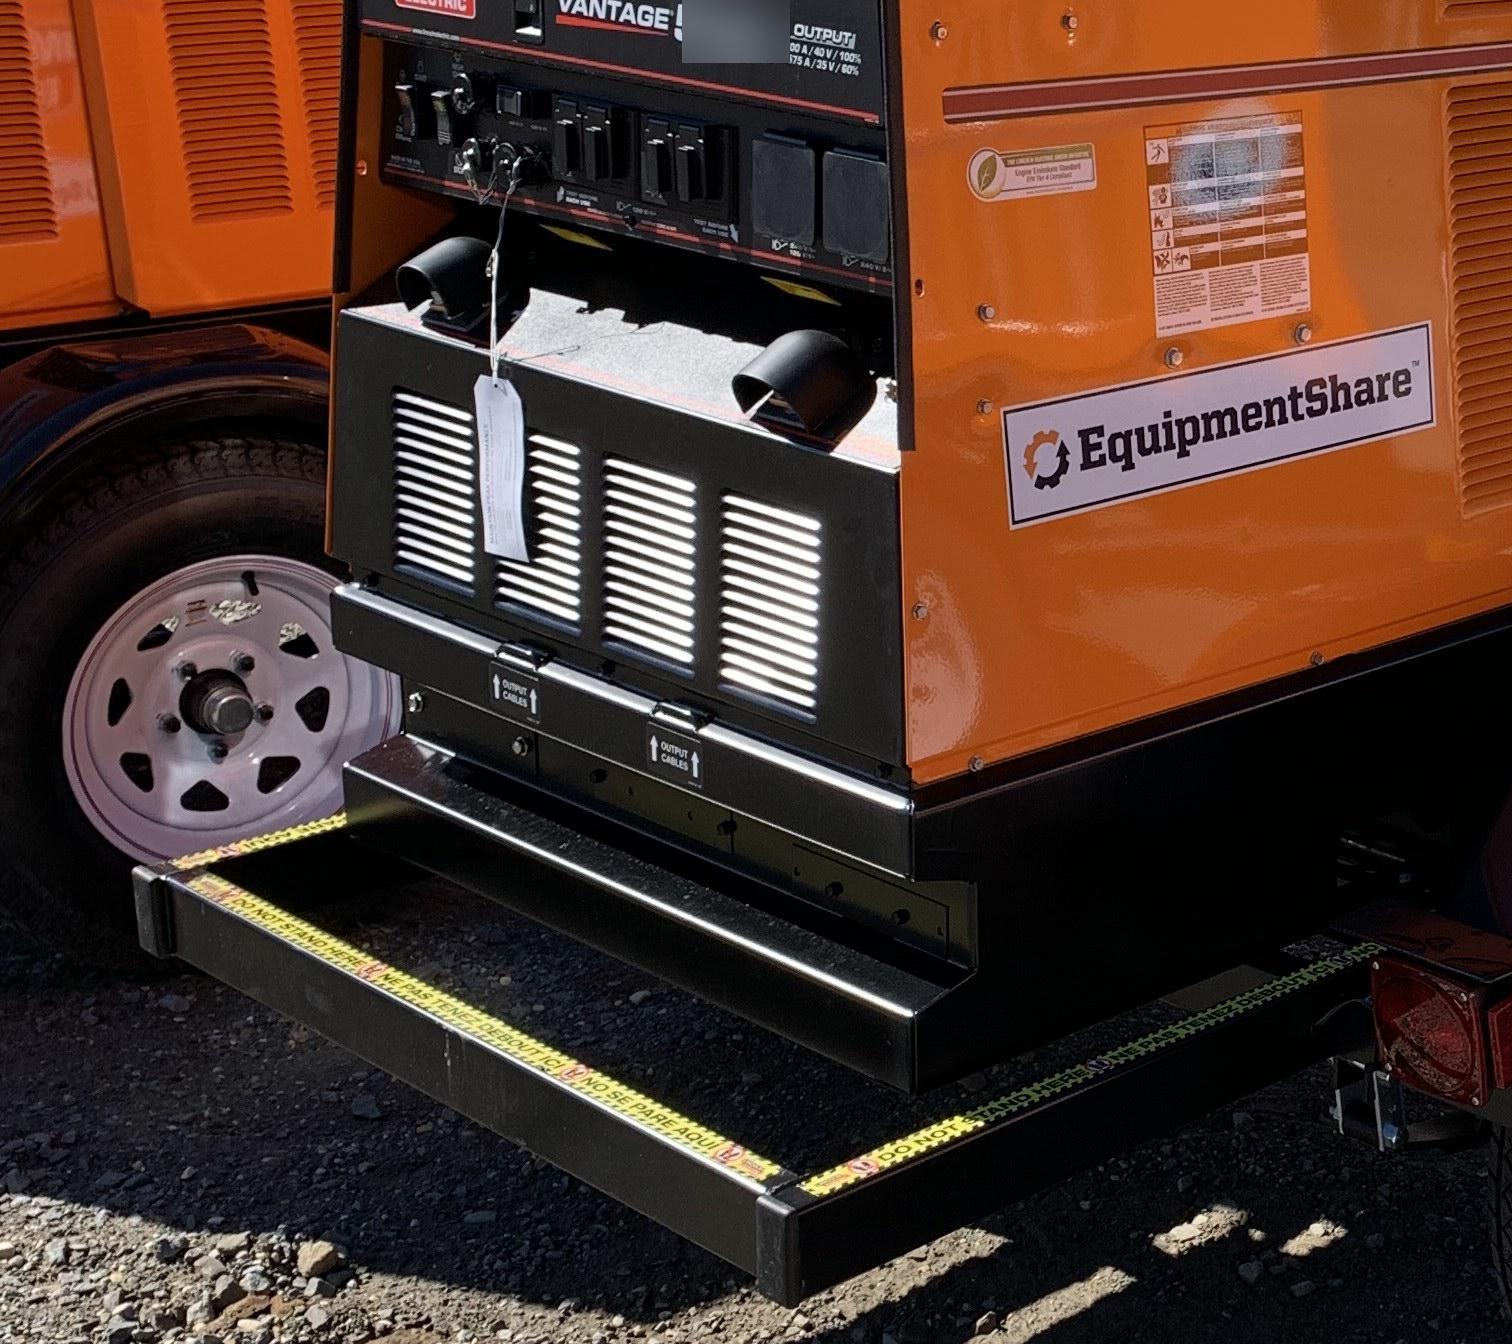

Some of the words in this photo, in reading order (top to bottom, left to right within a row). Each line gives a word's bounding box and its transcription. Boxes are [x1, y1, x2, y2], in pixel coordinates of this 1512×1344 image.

[794, 23, 852, 45] OUTPUT
[801, 45, 808, 54] A
[813, 47, 825, 58] 40
[826, 48, 833, 59] V
[839, 51, 862, 64] 100%
[803, 57, 811, 67] A
[816, 59, 827, 70] 35
[828, 61, 836, 72] V
[502, 678, 528, 696] OUTPUT
[502, 691, 528, 708] CABLES
[660, 740, 689, 759] OUTPUT
[660, 753, 689, 772] CABLES
[231, 897, 254, 913] DO
[252, 907, 283, 926] NOT
[280, 922, 328, 949] STAND
[324, 941, 364, 969] HERE
[378, 972, 399, 986] NE
[401, 982, 432, 1003] PAS
[479, 1021, 542, 1059] DEBOUT
[583, 1077, 609, 1093] NO
[606, 1089, 633, 1106] SE
[628, 1101, 678, 1130] PARE
[673, 1126, 722, 1151] AQUI
[877, 1143, 912, 1161] DO
[913, 1123, 960, 1146] NOT
[962, 1092, 1033, 1126] STAND
[1033, 1066, 1088, 1094] HERE
